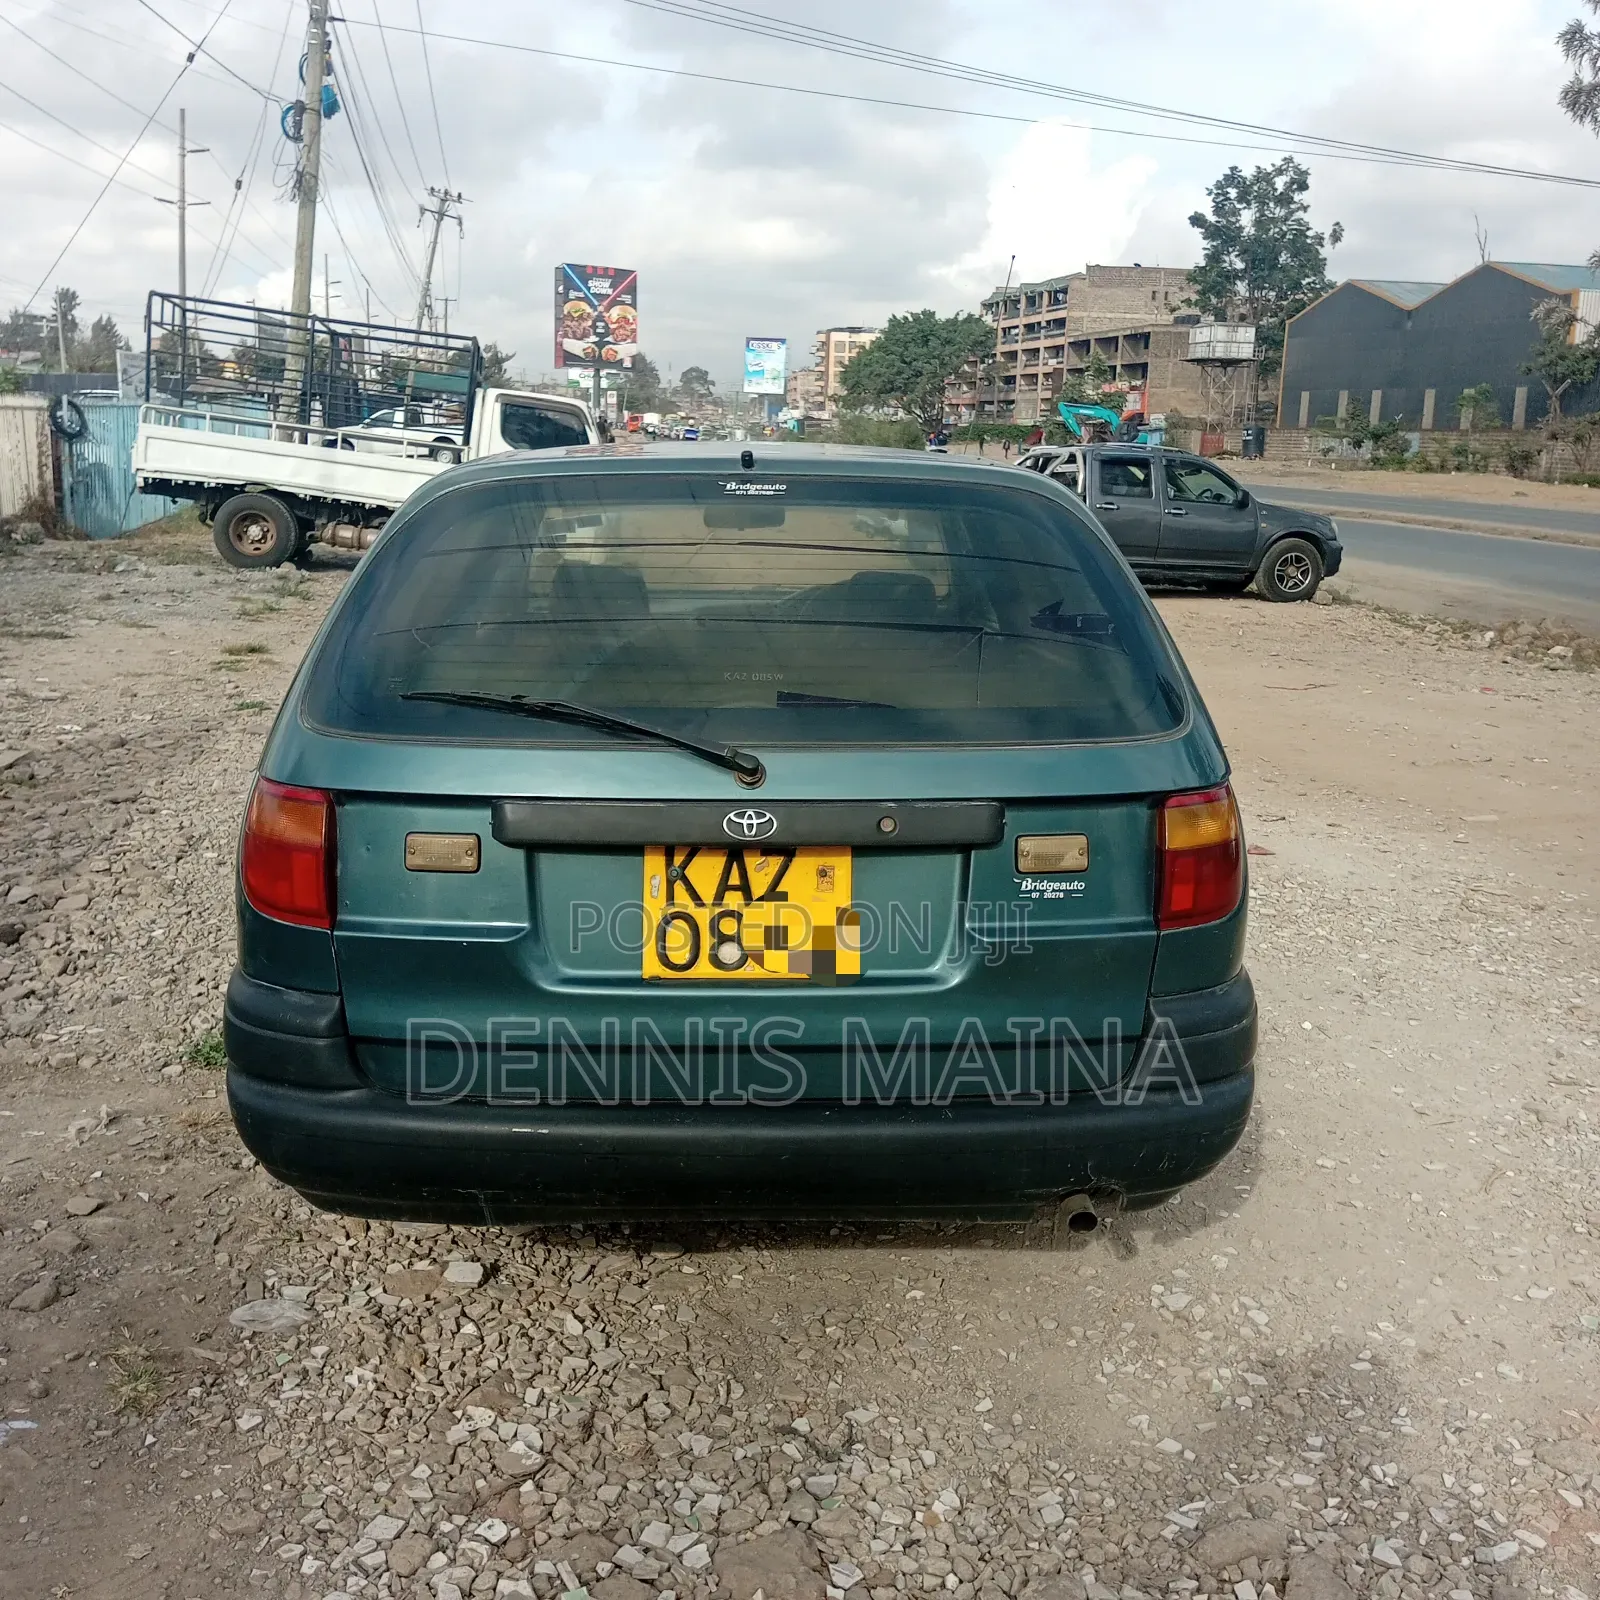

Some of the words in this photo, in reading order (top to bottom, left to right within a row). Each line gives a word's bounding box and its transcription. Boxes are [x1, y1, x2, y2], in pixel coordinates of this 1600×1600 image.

[587, 280, 611, 288] SHOW
[589, 287, 614, 295] DOWN
[717, 481, 787, 492] Bridgeauto
[664, 847, 797, 908] KAZ
[1013, 877, 1086, 892] Bridgeauto
